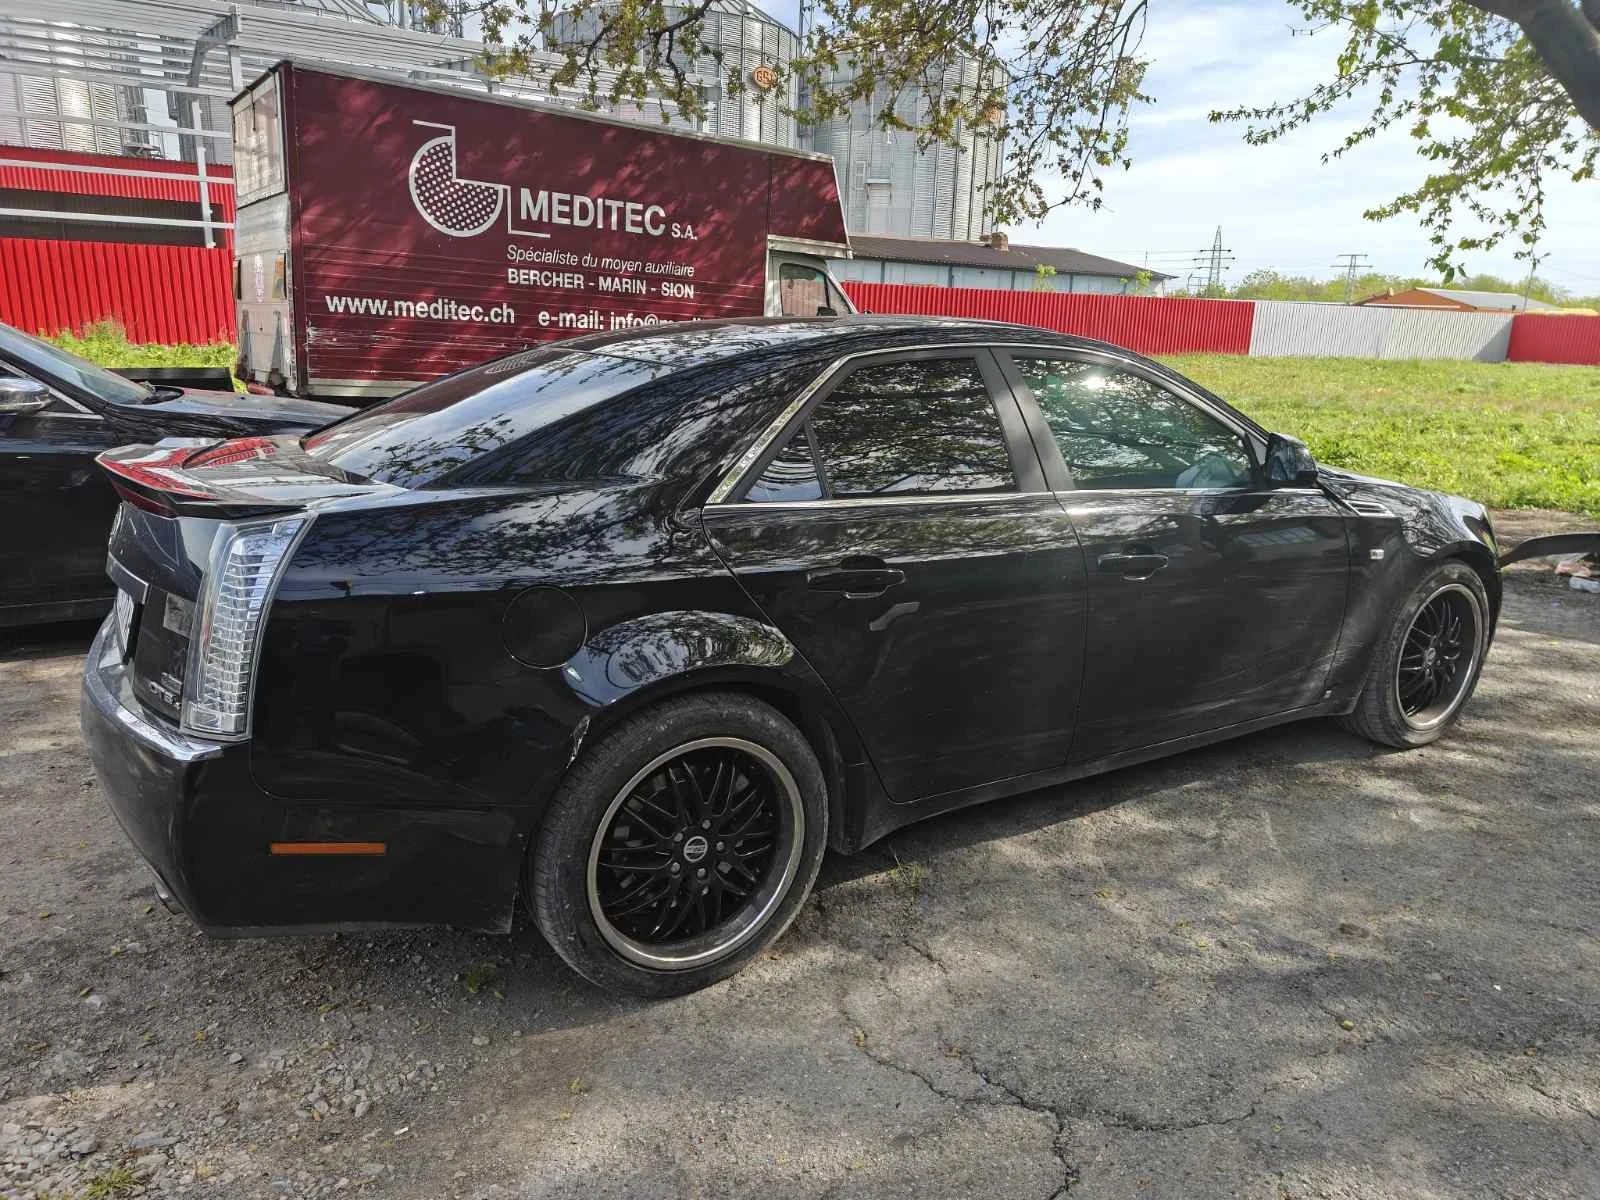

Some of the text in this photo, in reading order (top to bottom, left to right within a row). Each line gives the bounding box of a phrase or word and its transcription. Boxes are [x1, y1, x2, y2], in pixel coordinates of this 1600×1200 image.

[520, 187, 698, 240] MEDITEC S.A.
[507, 245, 695, 277] Spécialiste du moyen auxiliaire
[508, 268, 584, 289] BERCHER
[598, 276, 646, 294] MARIN
[661, 282, 694, 298] SION
[325, 295, 515, 324] www.meditec.ch
[538, 309, 604, 330] e-mail:
